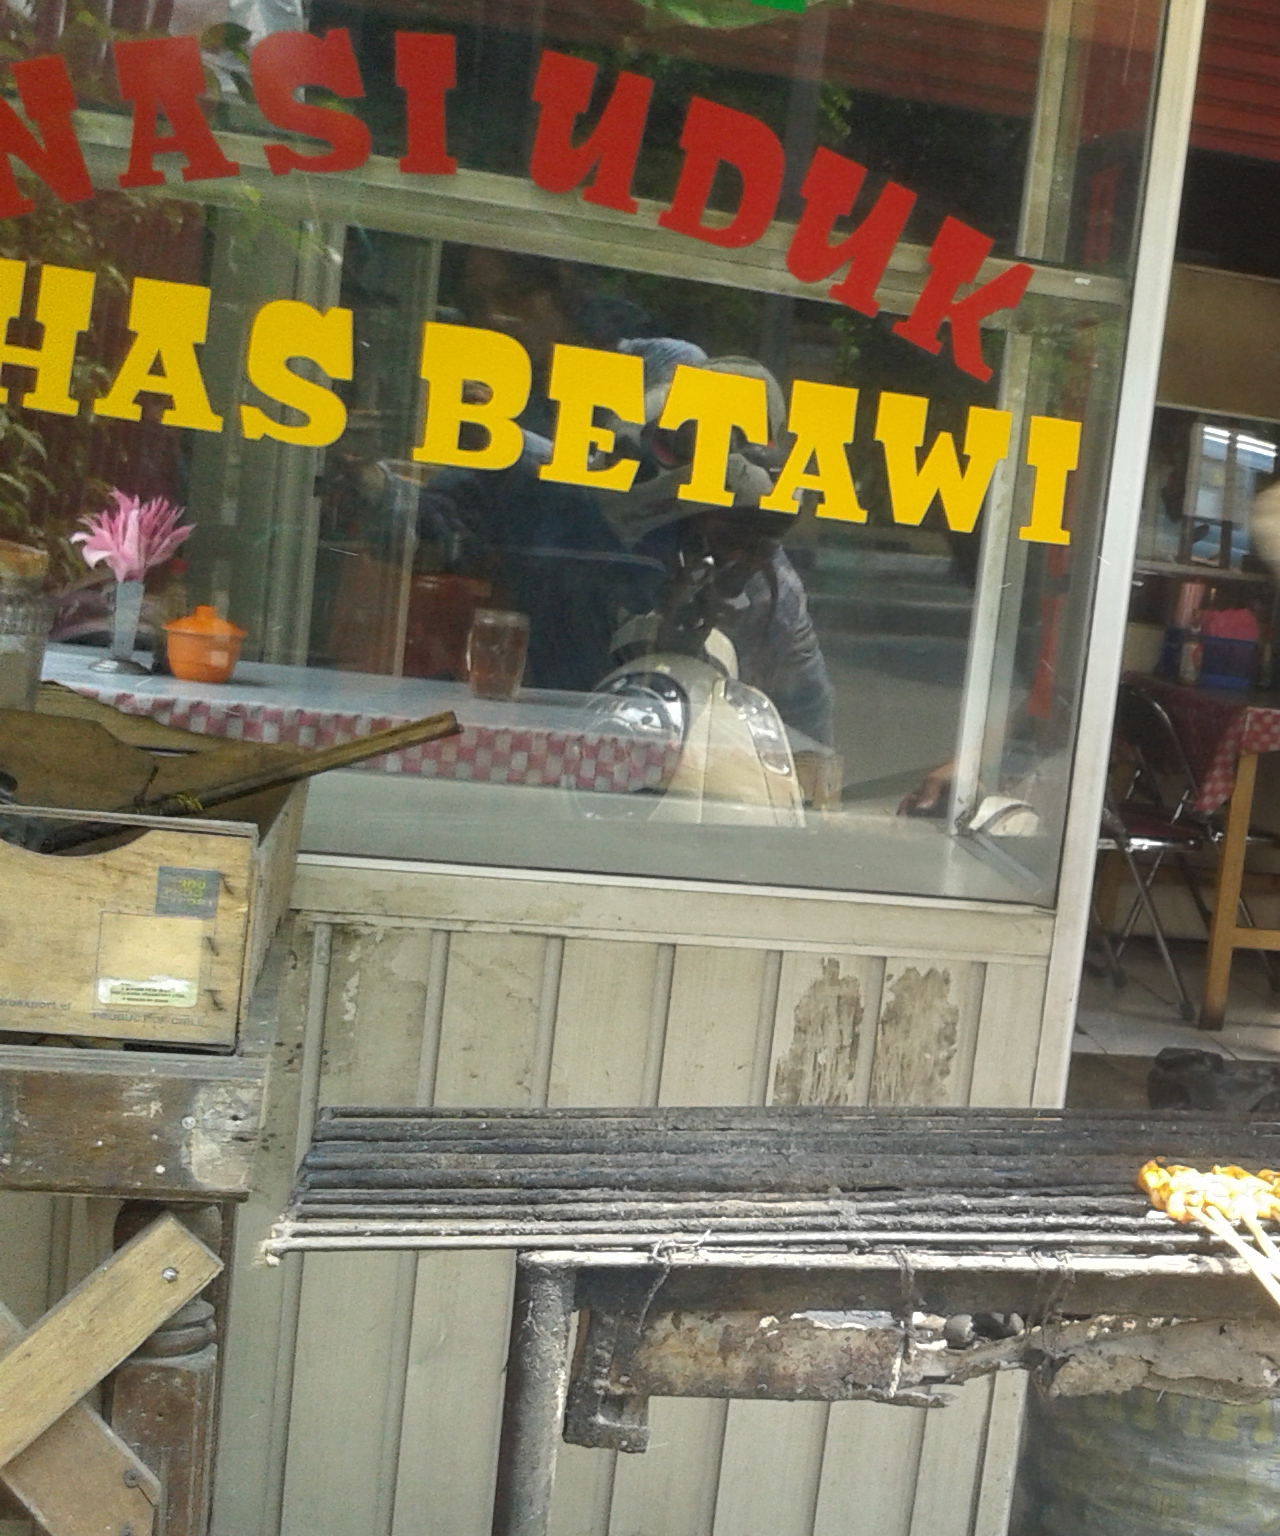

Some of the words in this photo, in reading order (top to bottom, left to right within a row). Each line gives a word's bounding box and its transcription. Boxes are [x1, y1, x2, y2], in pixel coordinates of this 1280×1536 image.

[0, 27, 457, 218] NASI
[530, 49, 1035, 382] UDUK
[412, 321, 1082, 545] BETAWI
